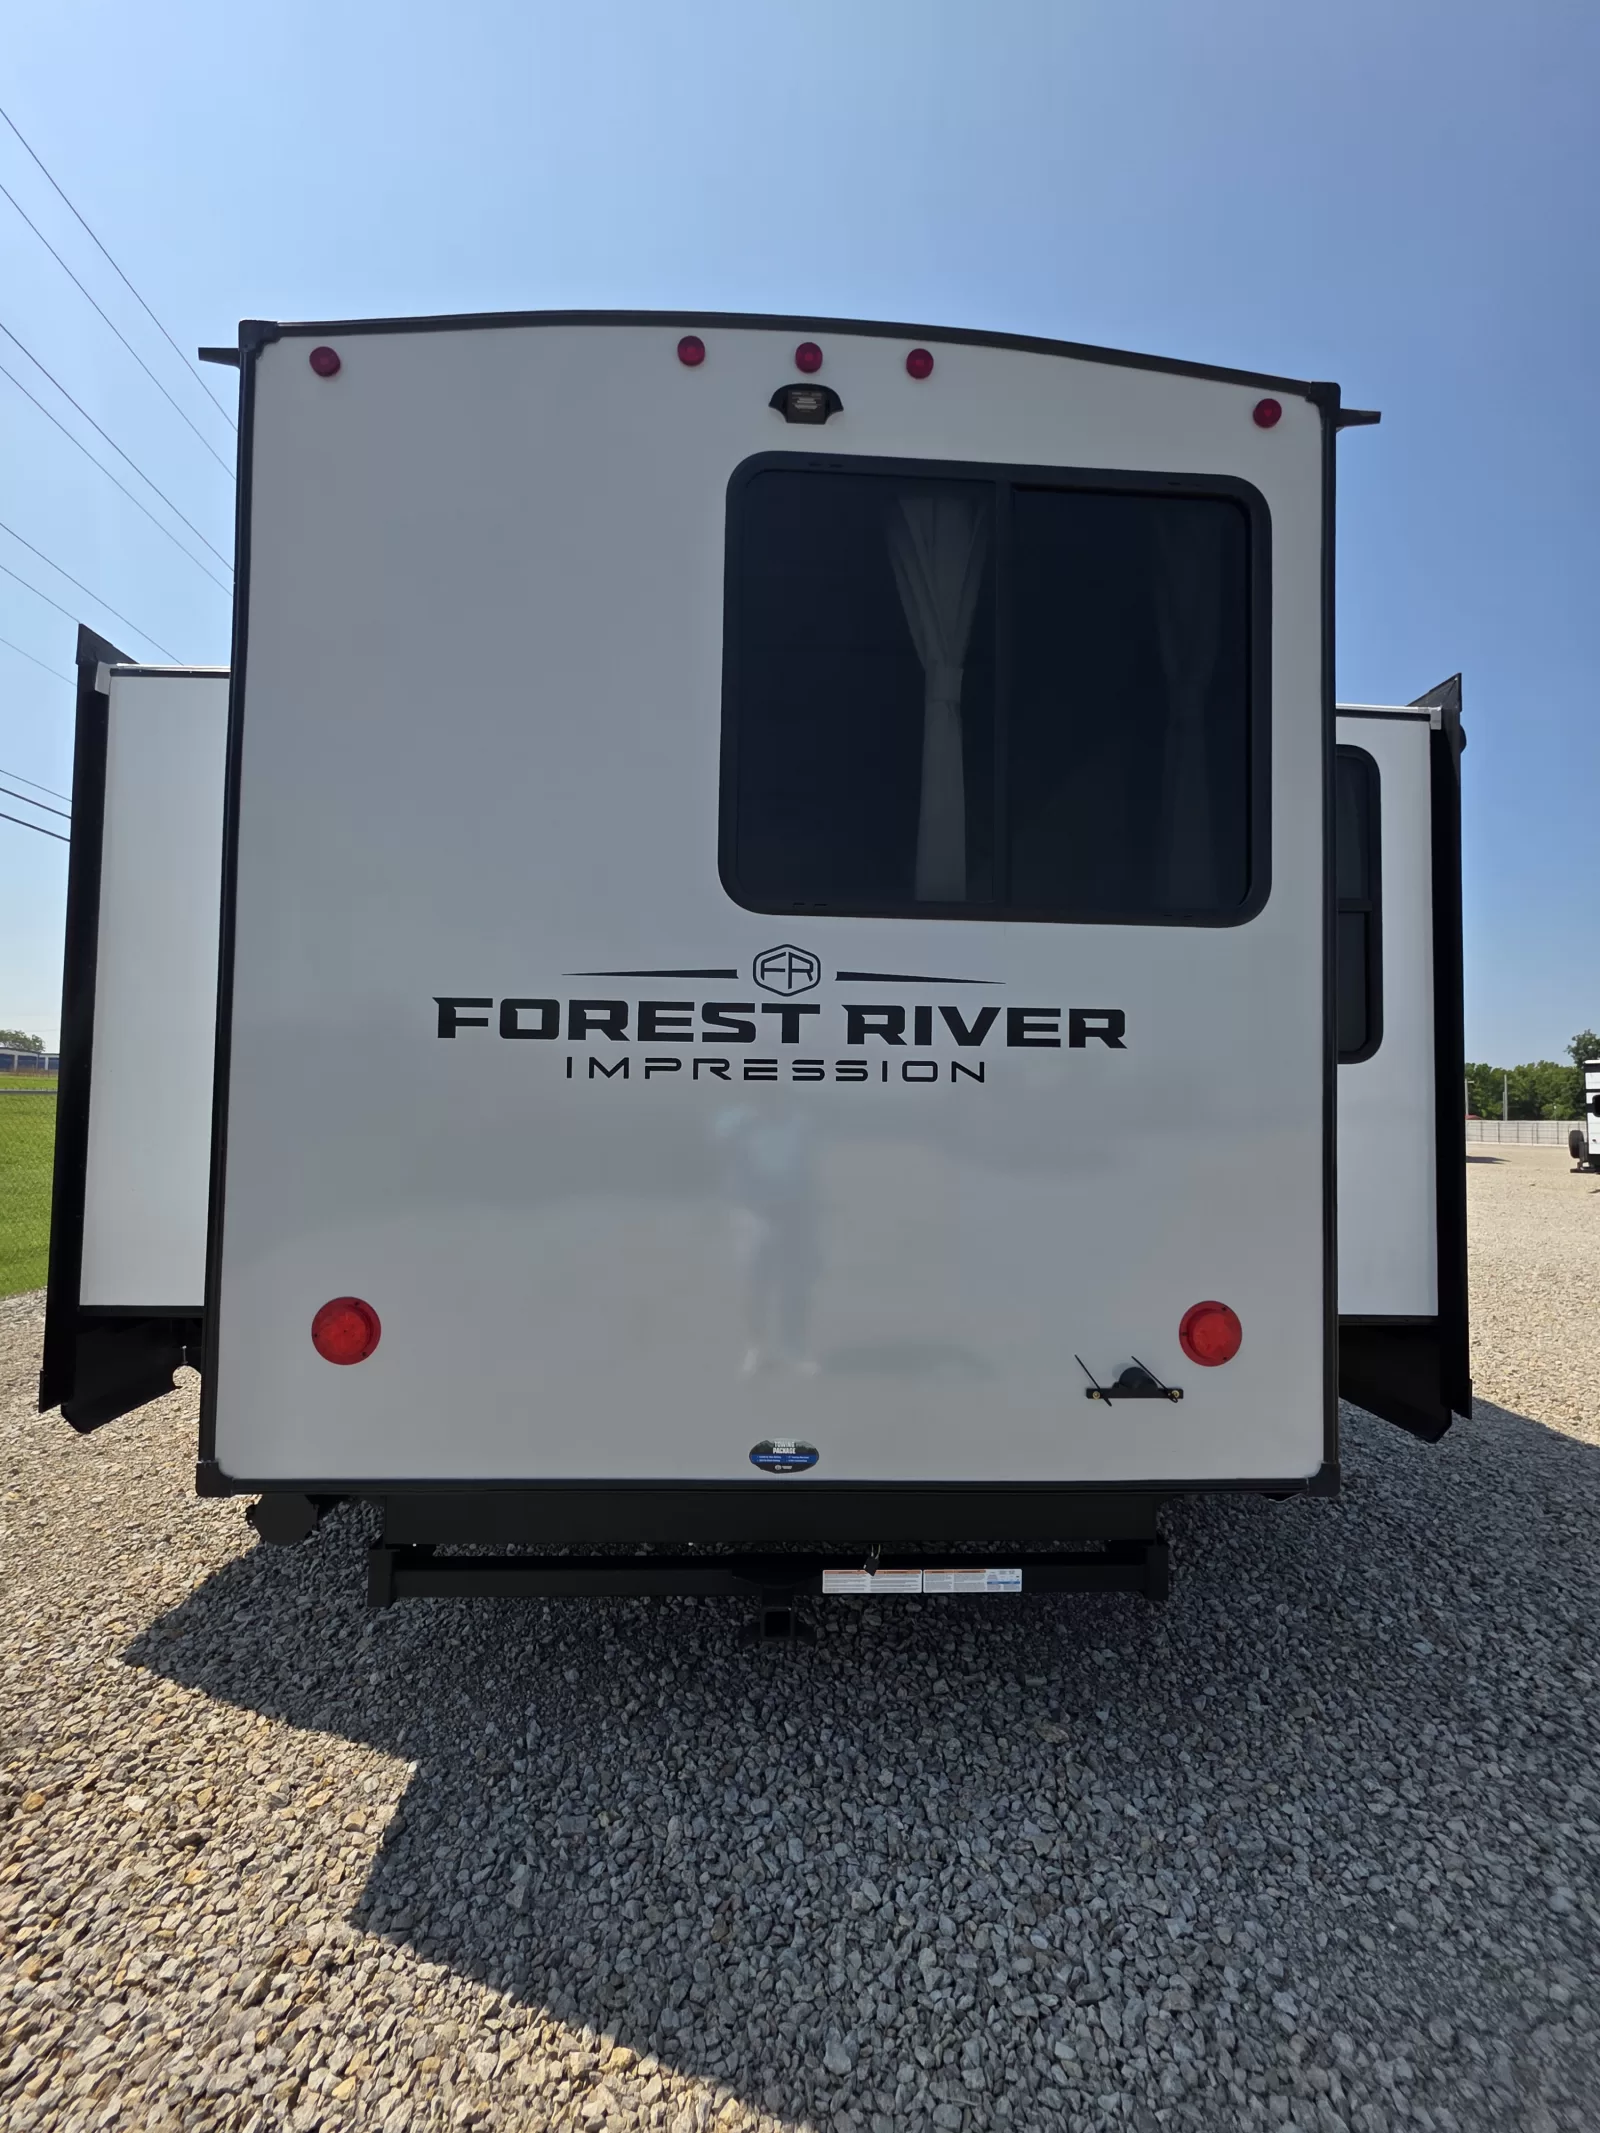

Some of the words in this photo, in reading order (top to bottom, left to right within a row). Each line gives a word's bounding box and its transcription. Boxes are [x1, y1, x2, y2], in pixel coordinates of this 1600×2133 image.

[760, 951, 814, 990] FR
[433, 996, 821, 1044] FOREST
[841, 1004, 1128, 1050] RIVER
[566, 1056, 985, 1084] IMPRESSION
